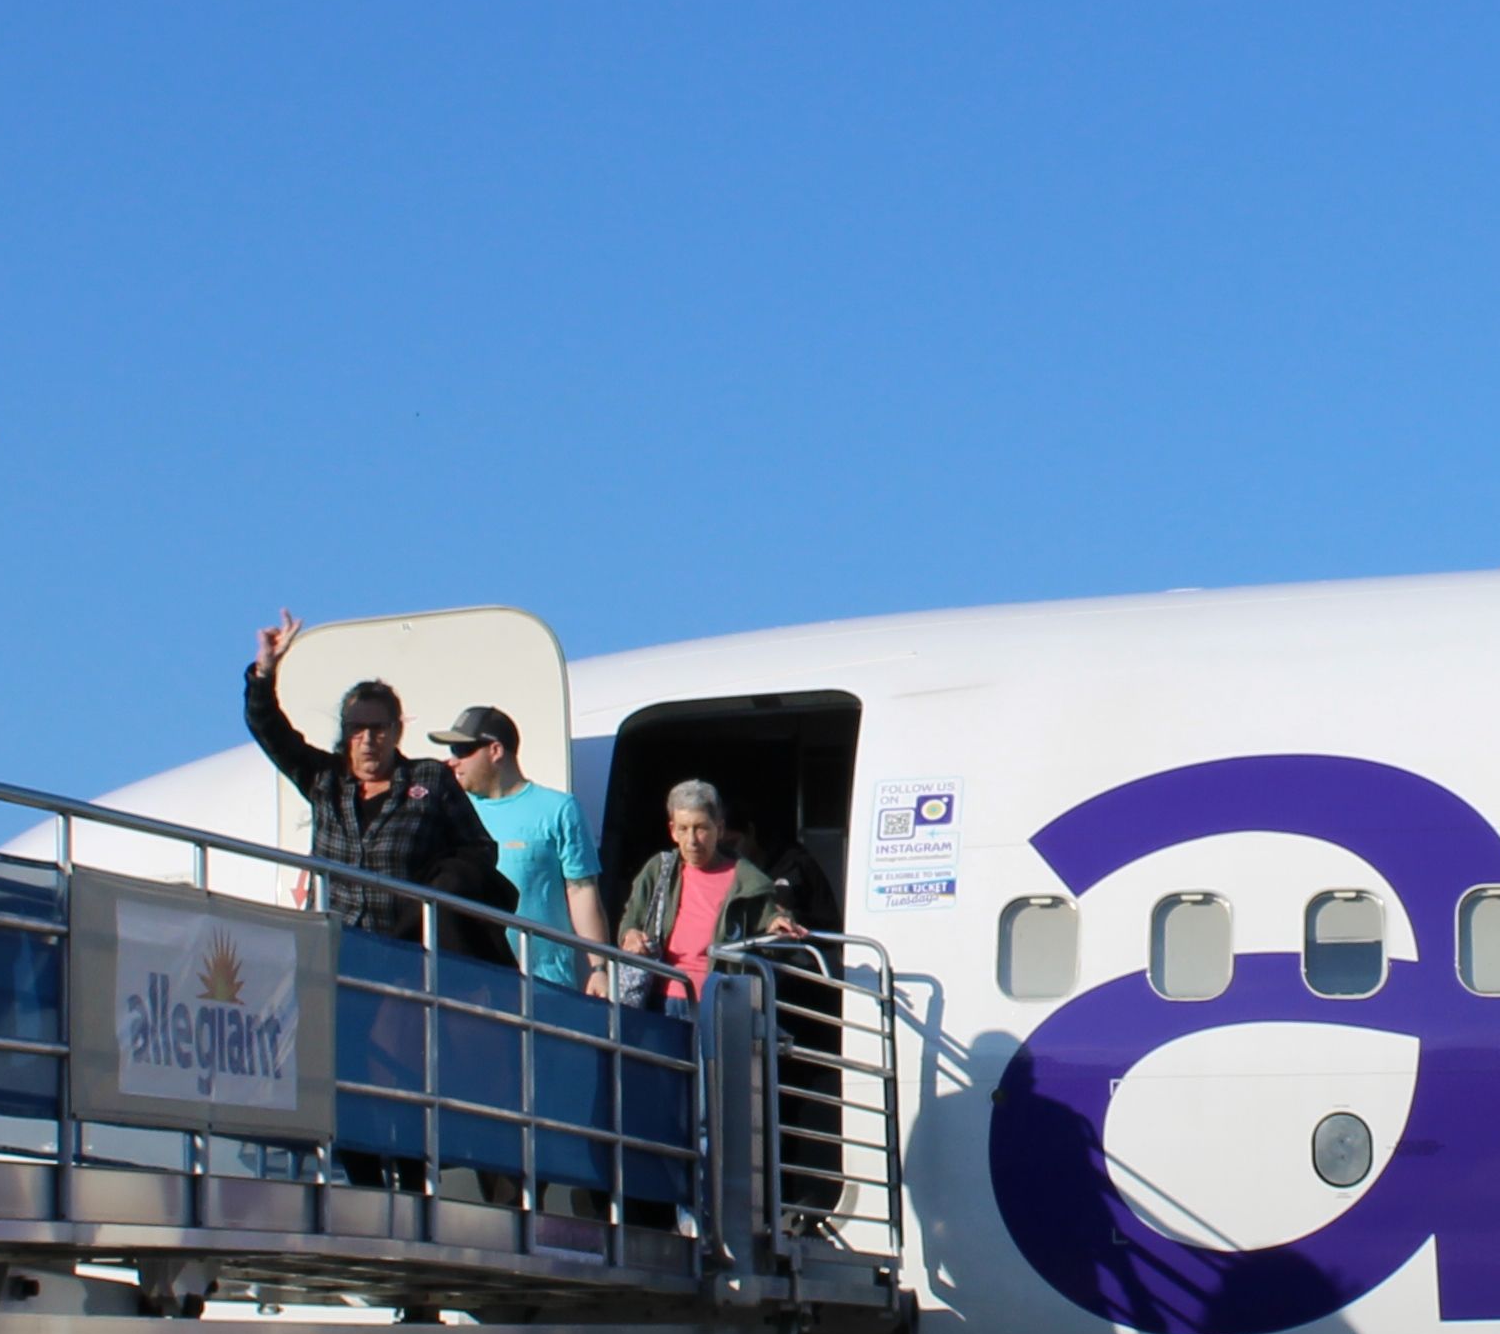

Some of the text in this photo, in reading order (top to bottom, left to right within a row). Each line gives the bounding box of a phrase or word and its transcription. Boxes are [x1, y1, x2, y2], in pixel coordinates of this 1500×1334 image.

[881, 781, 956, 794] FOLLOW US
[880, 795, 899, 805] ON
[875, 842, 953, 855] INSTAGRAM
[912, 881, 948, 893] TICKET
[127, 972, 282, 1096] allegiant
